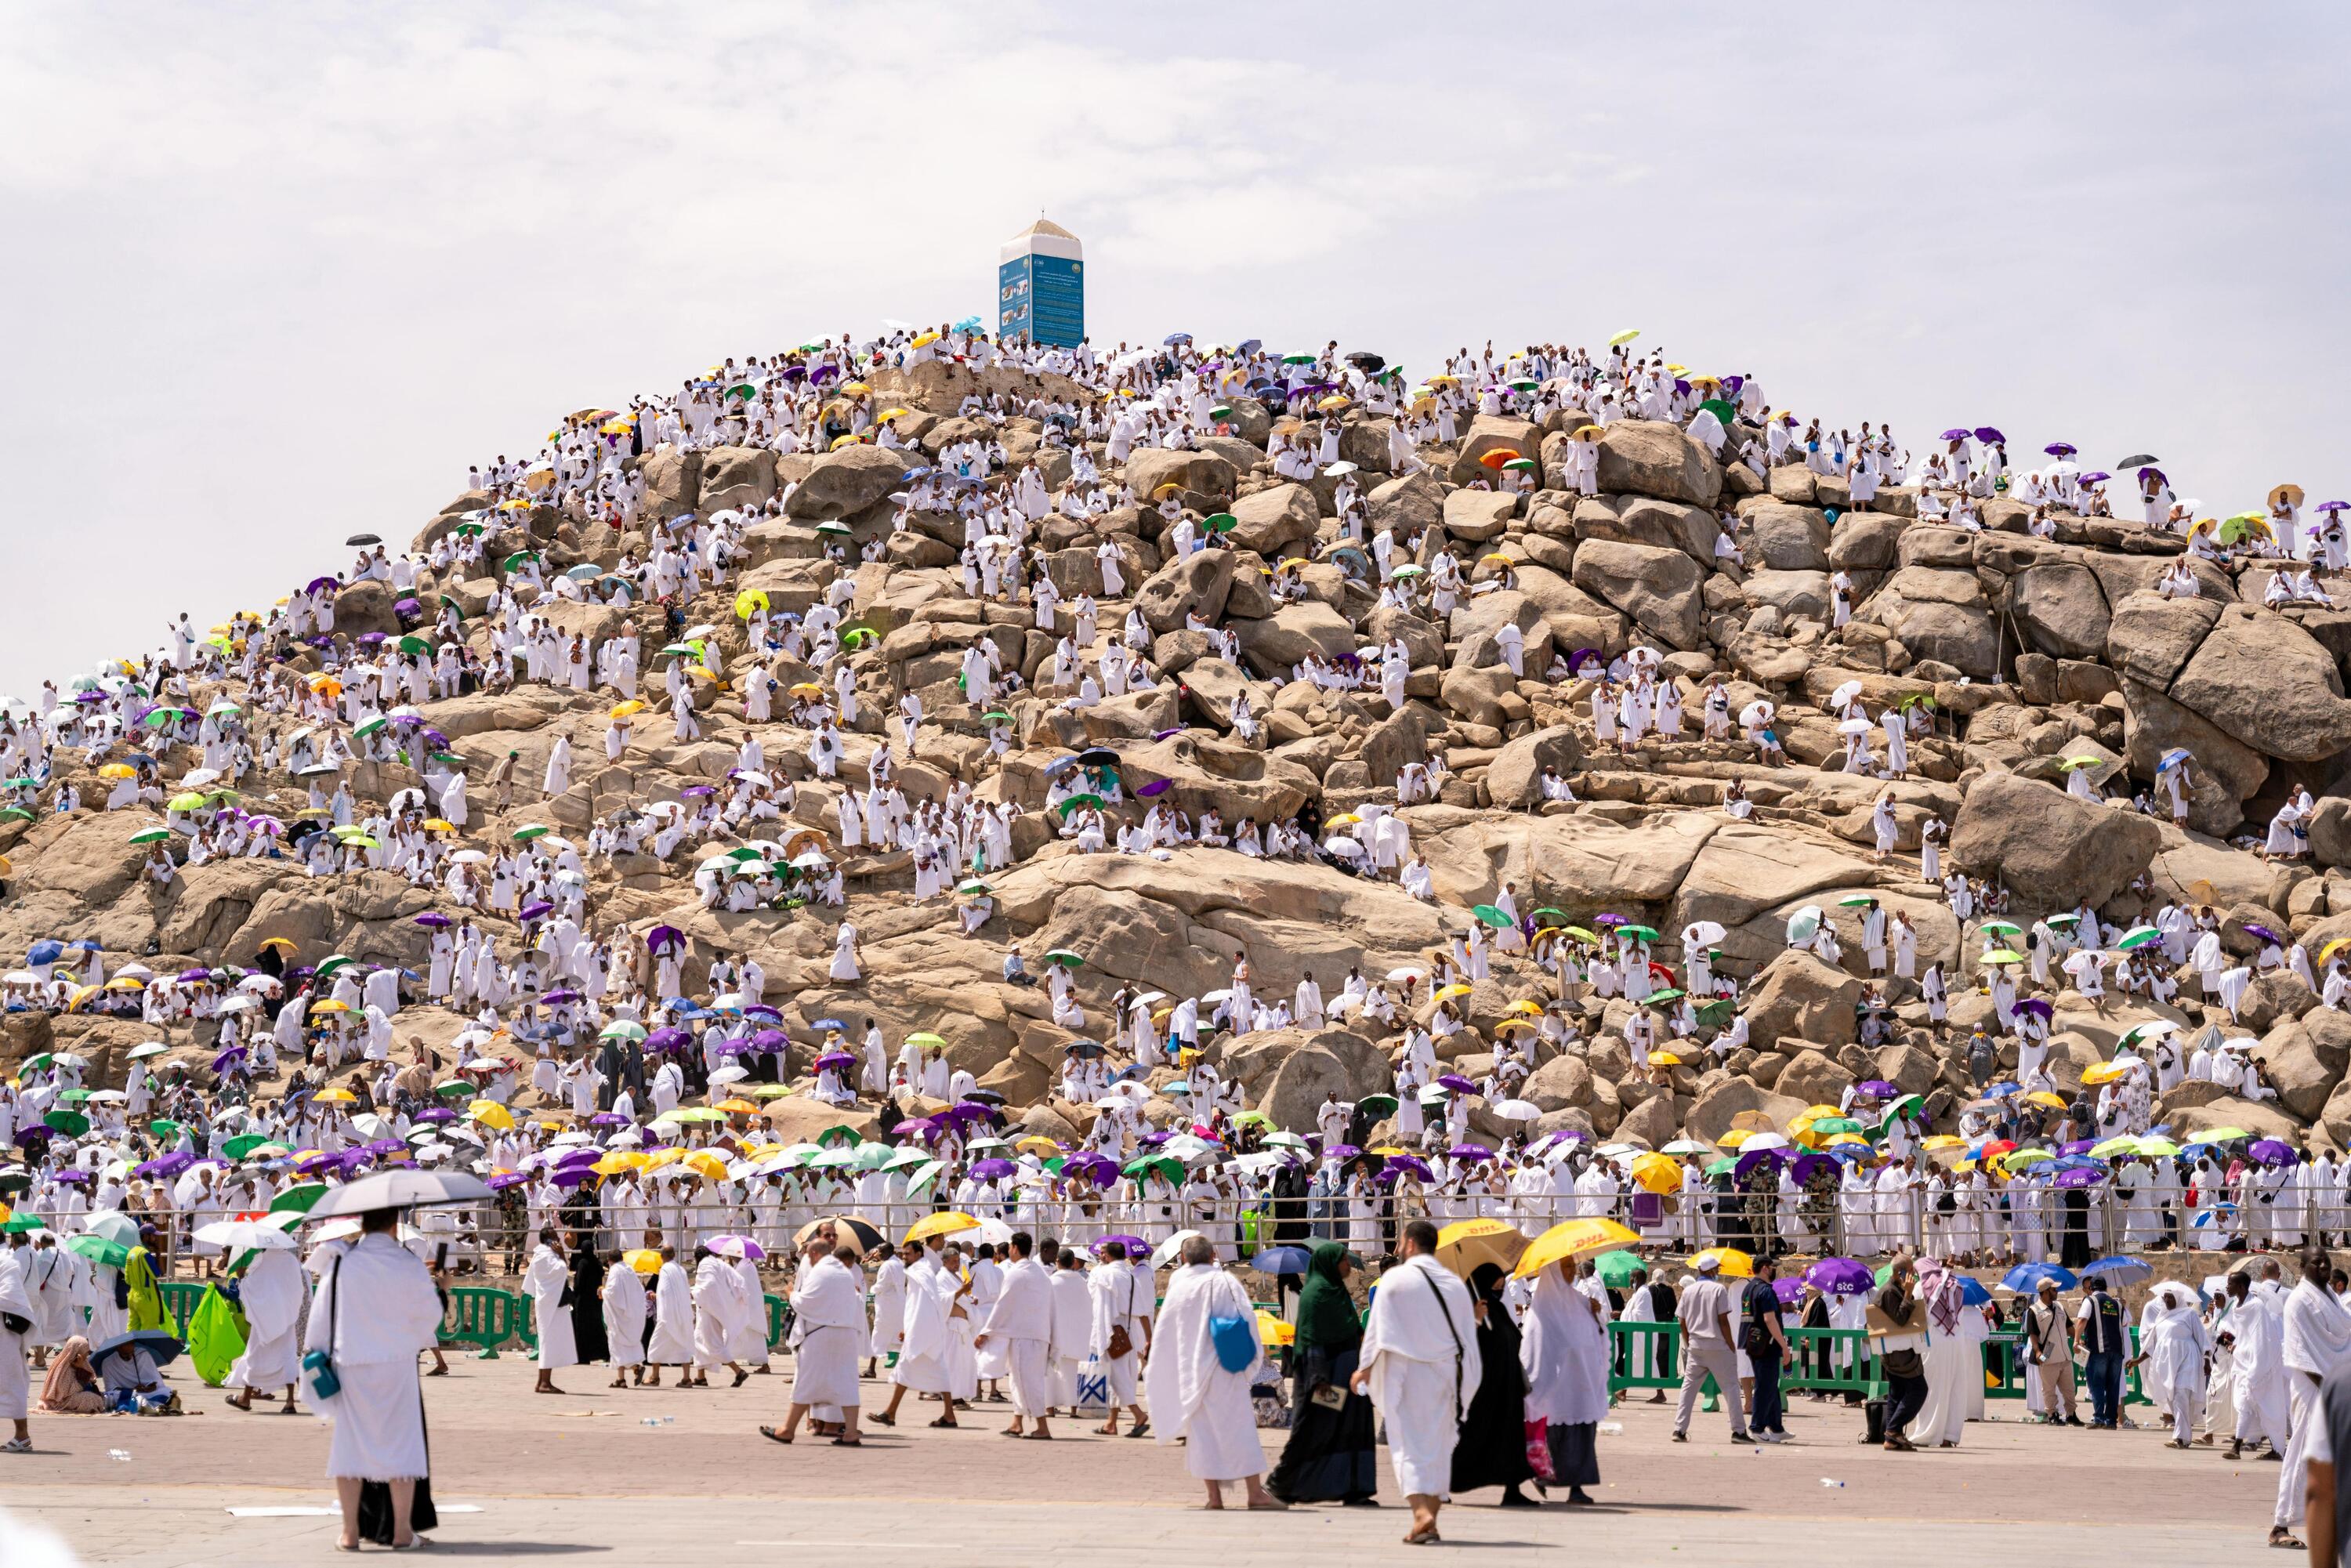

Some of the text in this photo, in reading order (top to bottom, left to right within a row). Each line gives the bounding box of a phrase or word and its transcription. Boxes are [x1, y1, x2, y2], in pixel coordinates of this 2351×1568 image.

[691, 1163, 704, 1172] DHL
[1636, 1174, 1646, 1185] DHL
[1668, 1183, 1680, 1192] DHL
[1470, 1225, 1497, 1233] DHL
[1577, 1234, 1604, 1248] DHL
